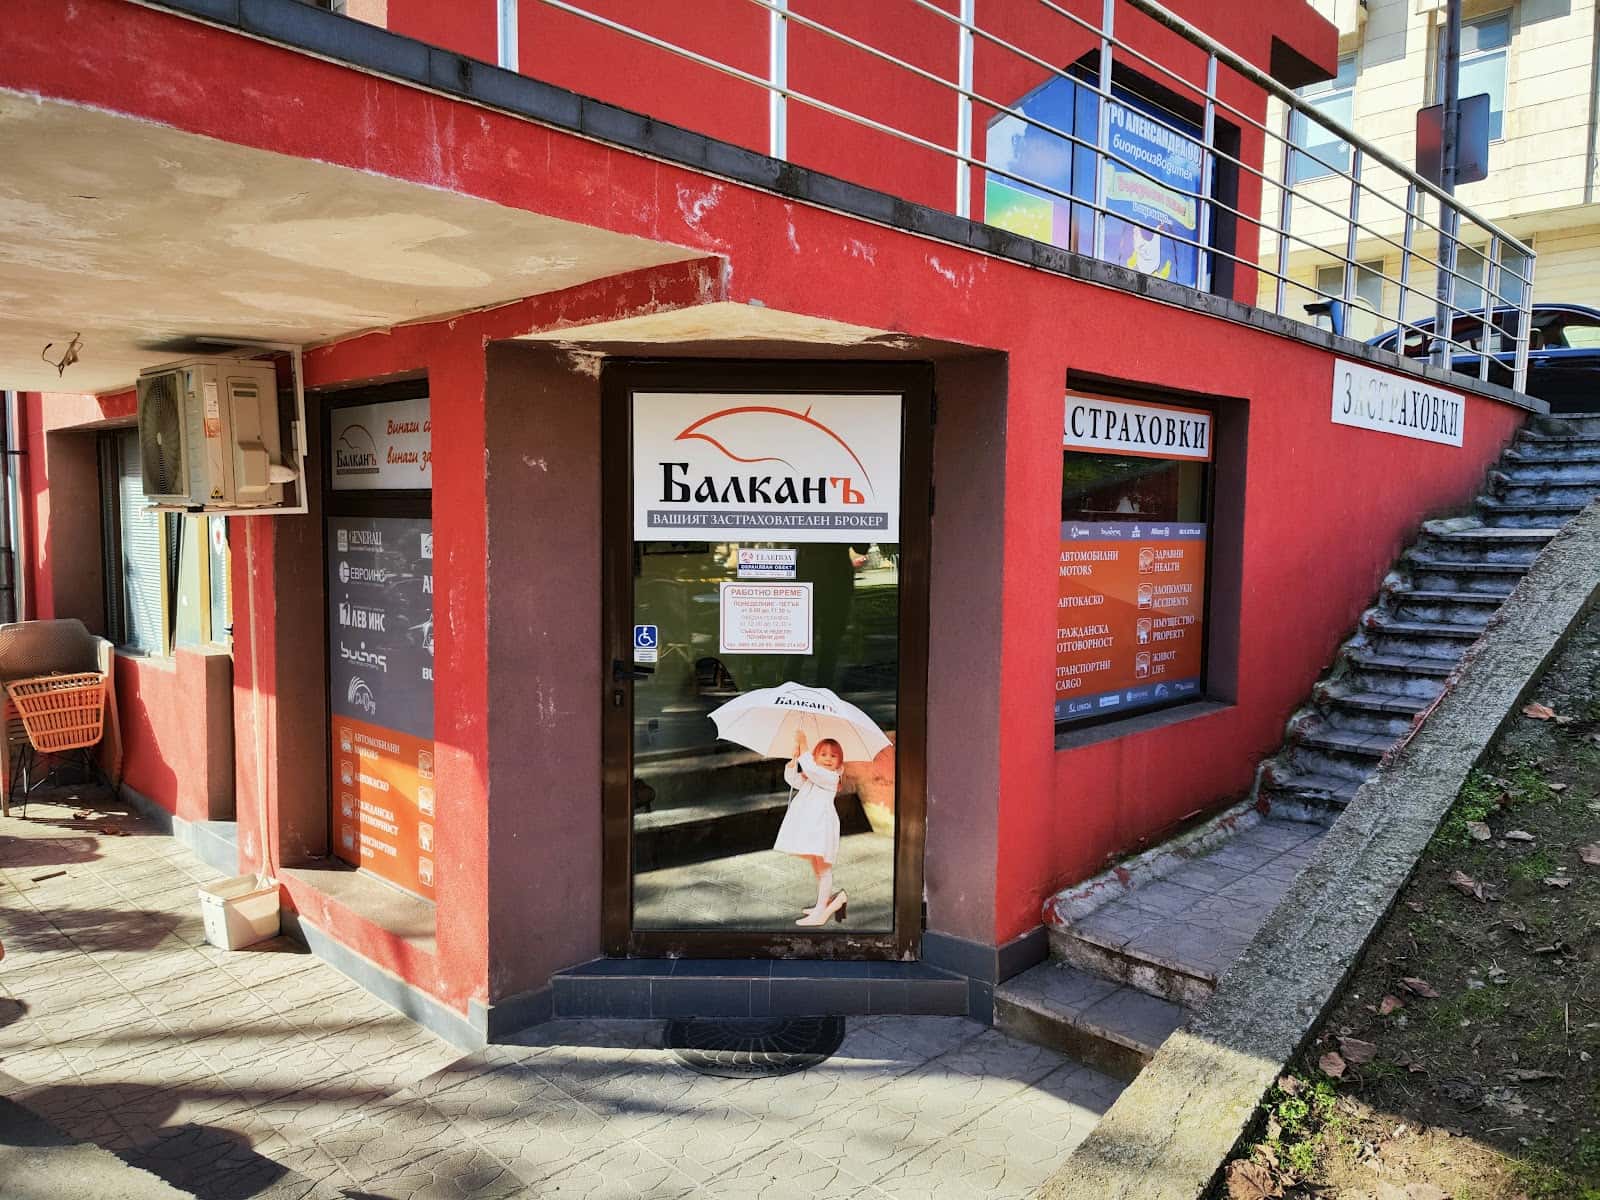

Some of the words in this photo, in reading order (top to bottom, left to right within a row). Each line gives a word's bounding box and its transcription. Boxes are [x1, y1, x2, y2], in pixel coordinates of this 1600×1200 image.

[1064, 405, 1207, 449] СТРАХОВКИ
[653, 513, 708, 526] ВАШИЯТ
[710, 513, 830, 527] ЗАСТРАХОВАТЕЛЕН
[834, 515, 883, 528] БРОКЕР
[349, 530, 382, 545] GENERALI
[1060, 550, 1119, 562] АВТОМОБИЛНИ
[1059, 564, 1093, 577] MOTORS
[1154, 562, 1180, 572] HEALTH
[731, 588, 771, 597] РАБОТНО
[773, 588, 803, 597] ВРЕМЕ
[1057, 594, 1104, 608] АВТОКАСКО
[352, 609, 367, 629] ЛЕВ
[368, 611, 386, 633] ИНС
[1056, 624, 1109, 639] ГРАЖДАНСКА
[1152, 629, 1185, 641] PROPERTY
[1056, 636, 1114, 653] ОТГОВОРНОСТ
[1056, 660, 1111, 677] ТРАНСПОРТНИ
[1152, 665, 1166, 675] LIFE
[1055, 678, 1081, 691] CARGO
